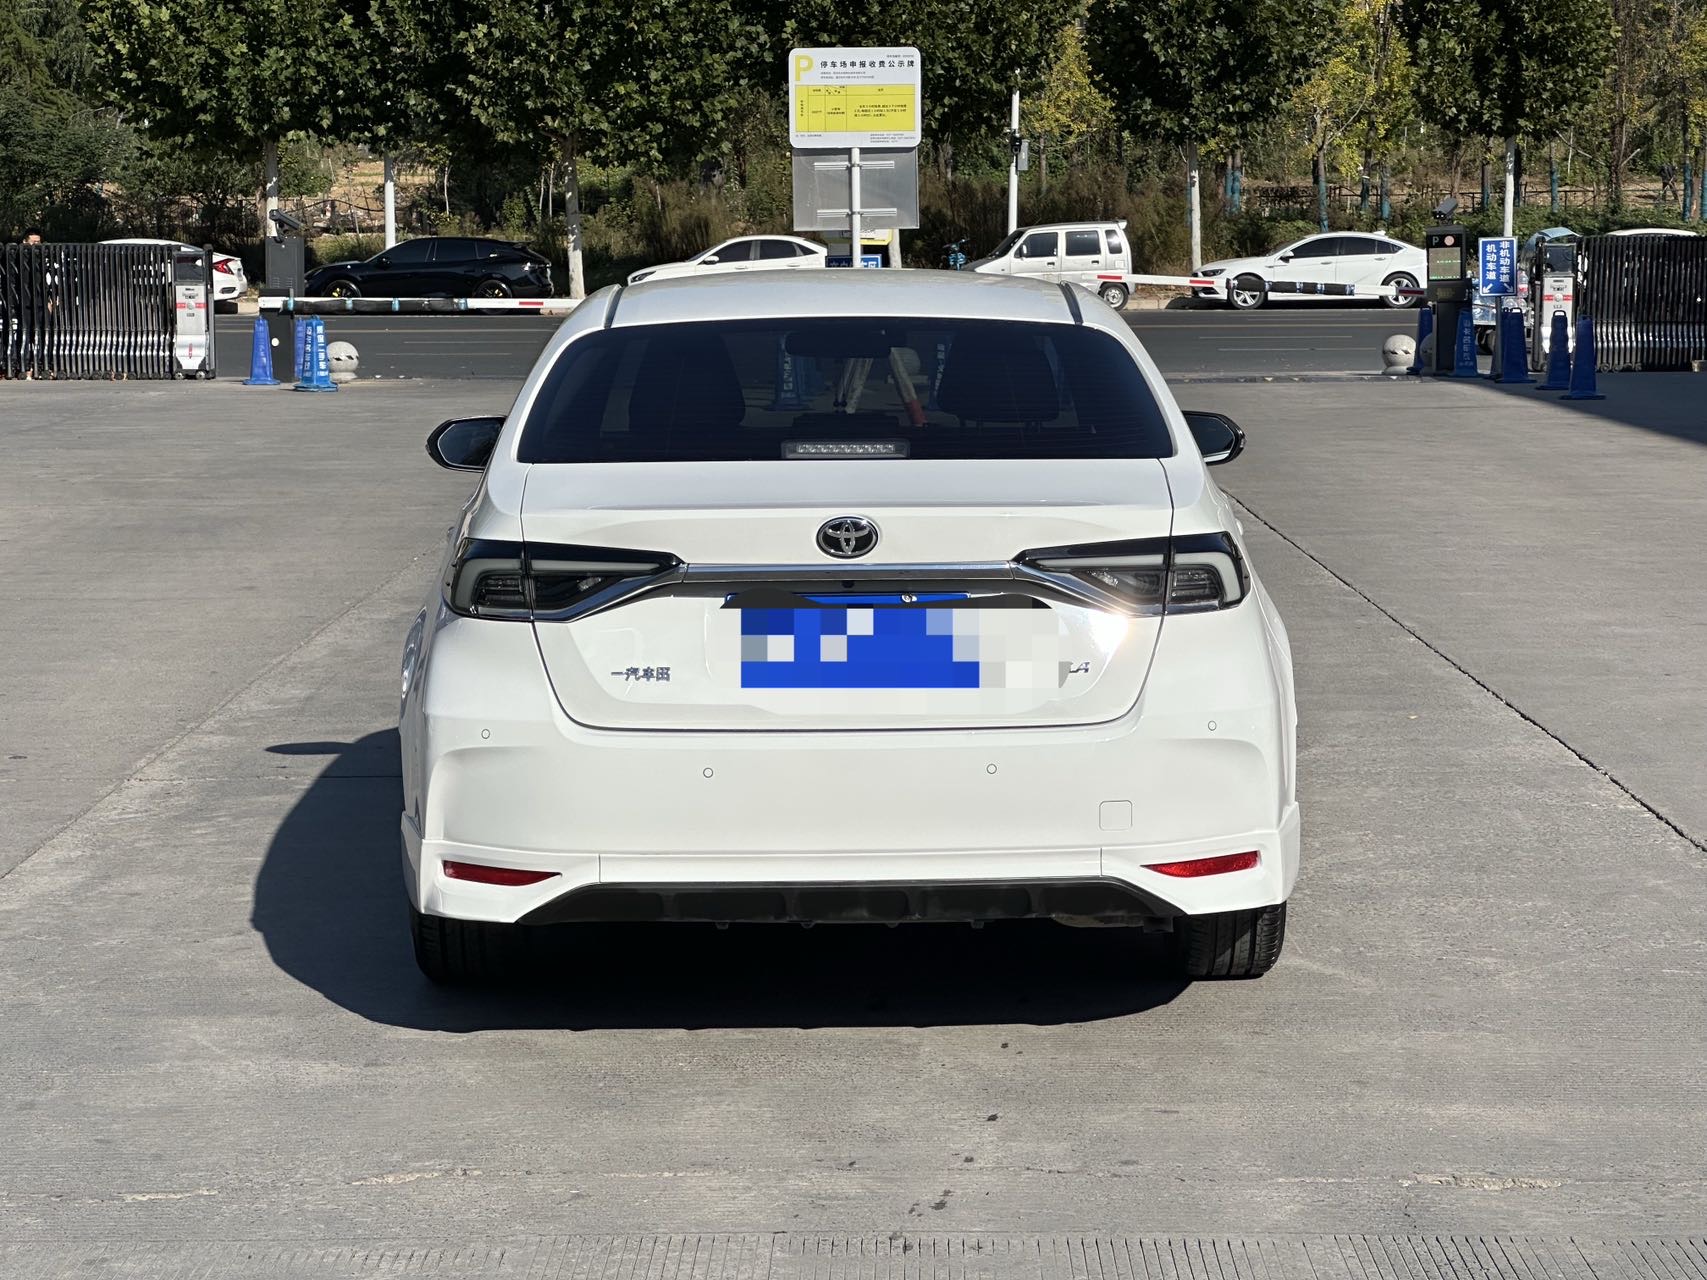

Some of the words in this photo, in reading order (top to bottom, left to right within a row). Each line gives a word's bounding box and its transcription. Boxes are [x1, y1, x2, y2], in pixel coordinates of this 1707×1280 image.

[794, 54, 814, 81] P
[820, 60, 915, 69] 停车场申报收费公示牌
[1432, 236, 1440, 246] P
[1486, 244, 1497, 280] 机动车道
[1499, 241, 1510, 283] 非机动车道
